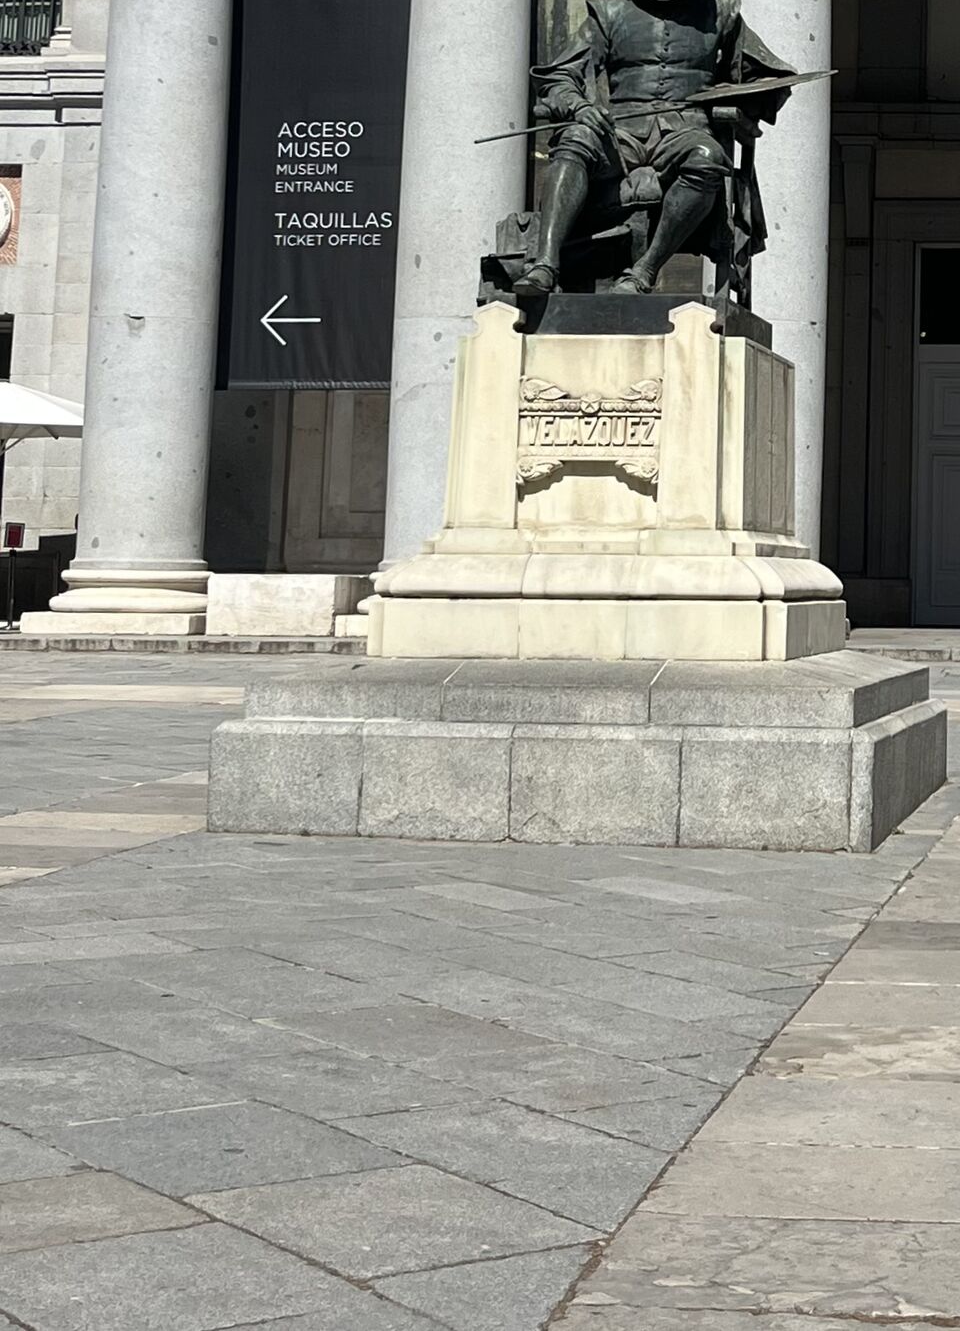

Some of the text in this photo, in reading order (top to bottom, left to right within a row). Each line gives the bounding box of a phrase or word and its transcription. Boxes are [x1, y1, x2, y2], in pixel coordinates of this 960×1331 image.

[278, 122, 363, 138] ACCESO
[278, 141, 350, 157] MUSEO
[277, 164, 337, 175] MUSEUM
[275, 181, 353, 192] ENTRANCE
[275, 212, 392, 228] TAQUILLAS
[274, 234, 381, 246] TICKET OFFICE
